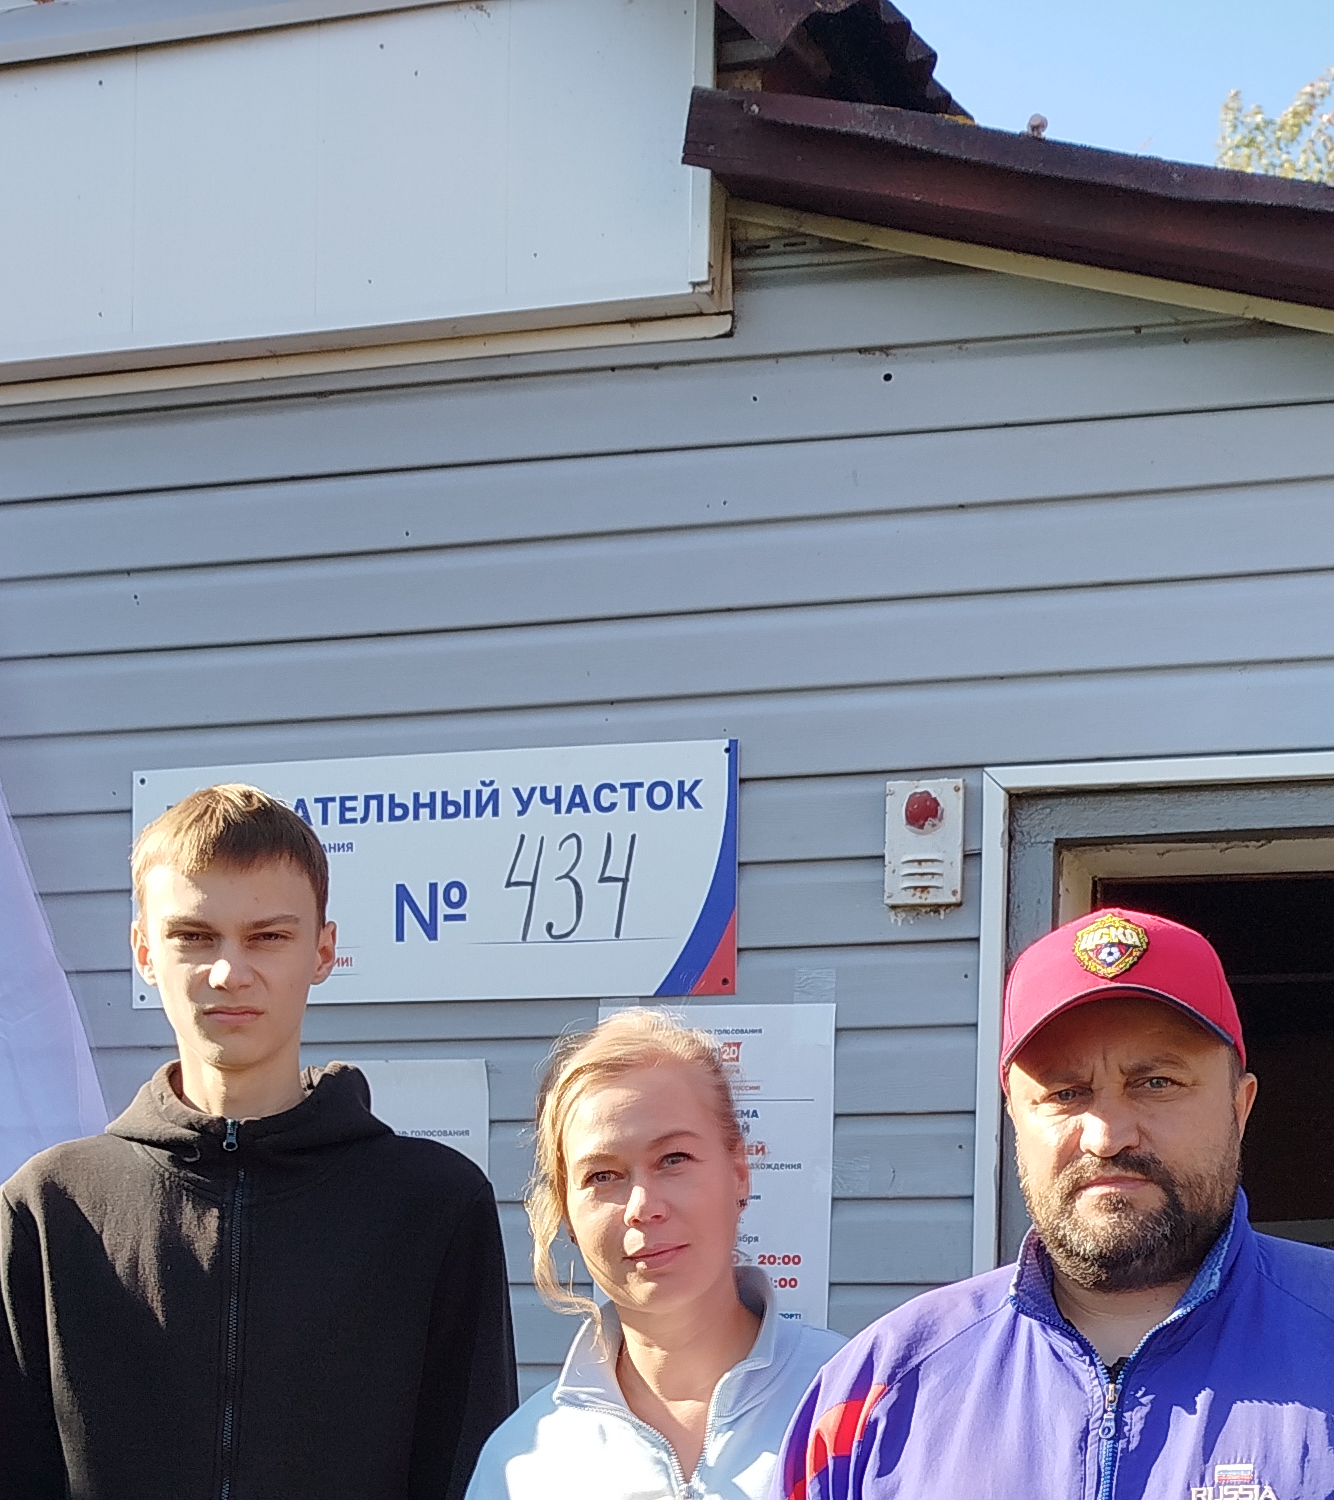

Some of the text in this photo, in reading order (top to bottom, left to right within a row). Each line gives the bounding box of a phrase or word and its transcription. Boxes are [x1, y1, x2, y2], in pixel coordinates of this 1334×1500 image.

[287, 778, 705, 827] АТЕЛЬНЫЙ УЧАСТОК
[395, 832, 638, 943] № 434
[757, 1254, 802, 1266] 20:00
